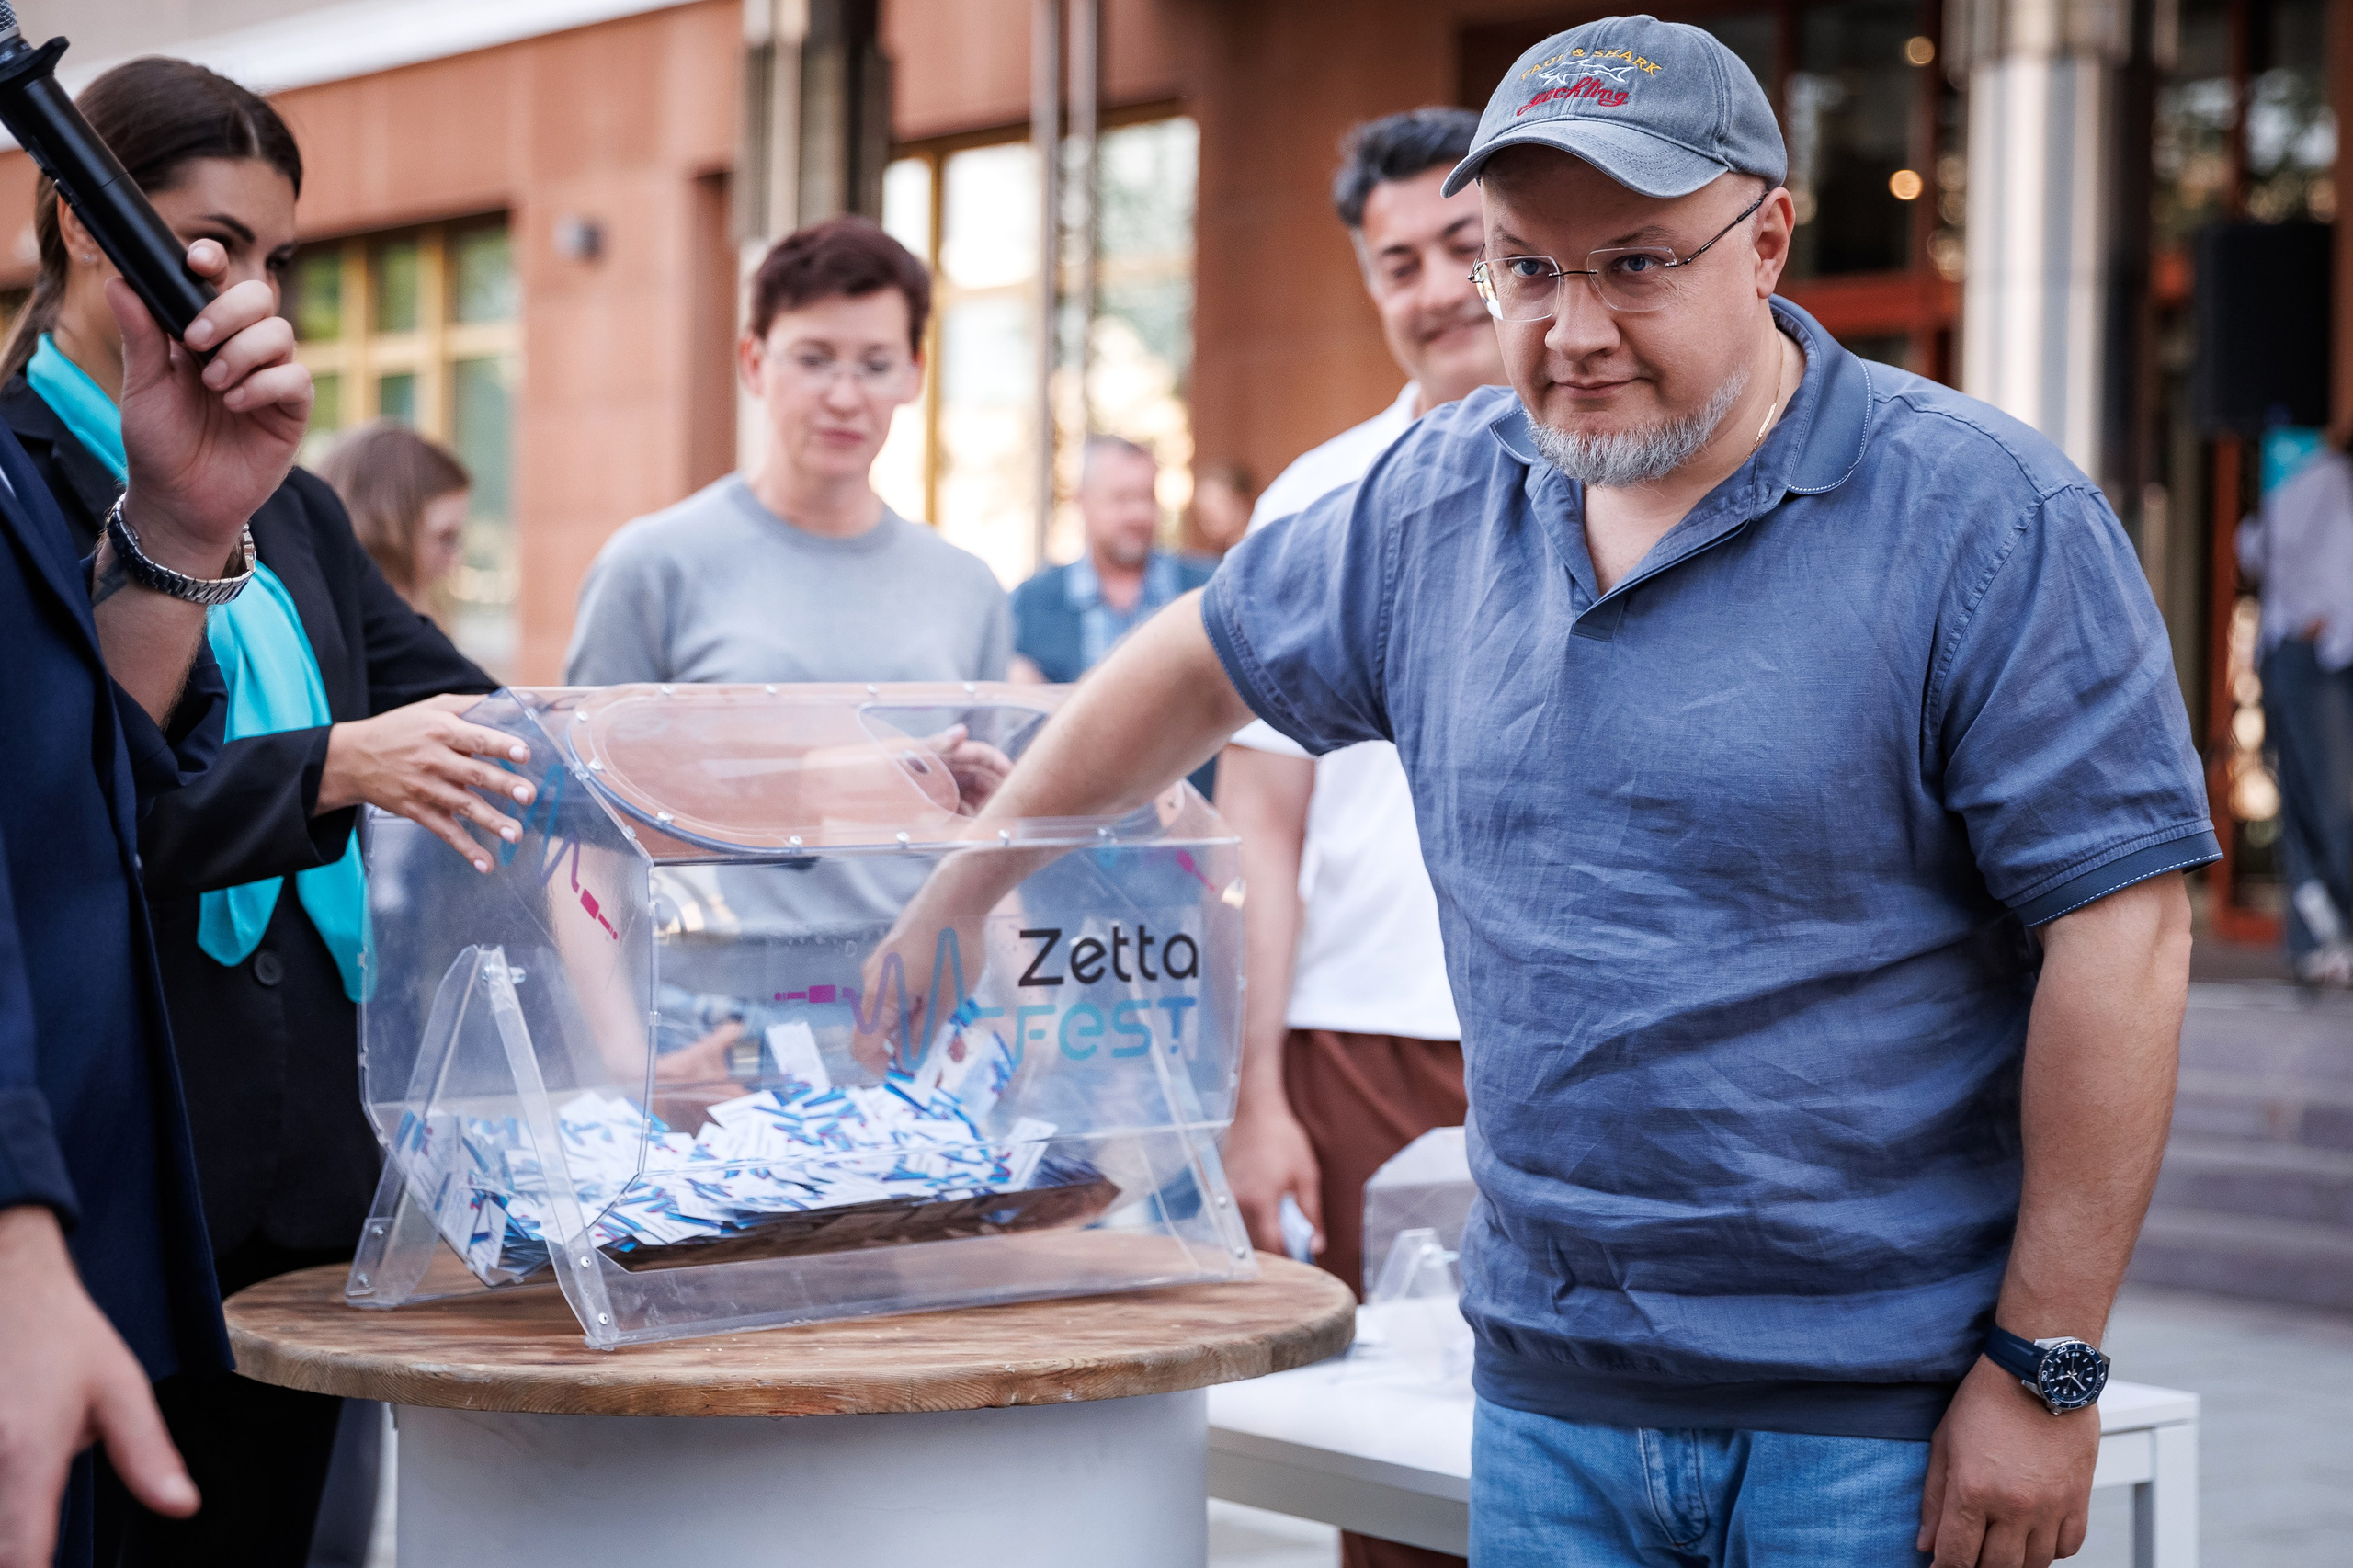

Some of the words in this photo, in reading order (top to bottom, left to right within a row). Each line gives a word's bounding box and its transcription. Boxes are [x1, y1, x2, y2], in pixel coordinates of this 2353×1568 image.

[1572, 48, 1586, 57] &
[1592, 49, 1663, 76] SHARK
[1517, 77, 1629, 117] yachting
[1018, 925, 1199, 987] Zetta
